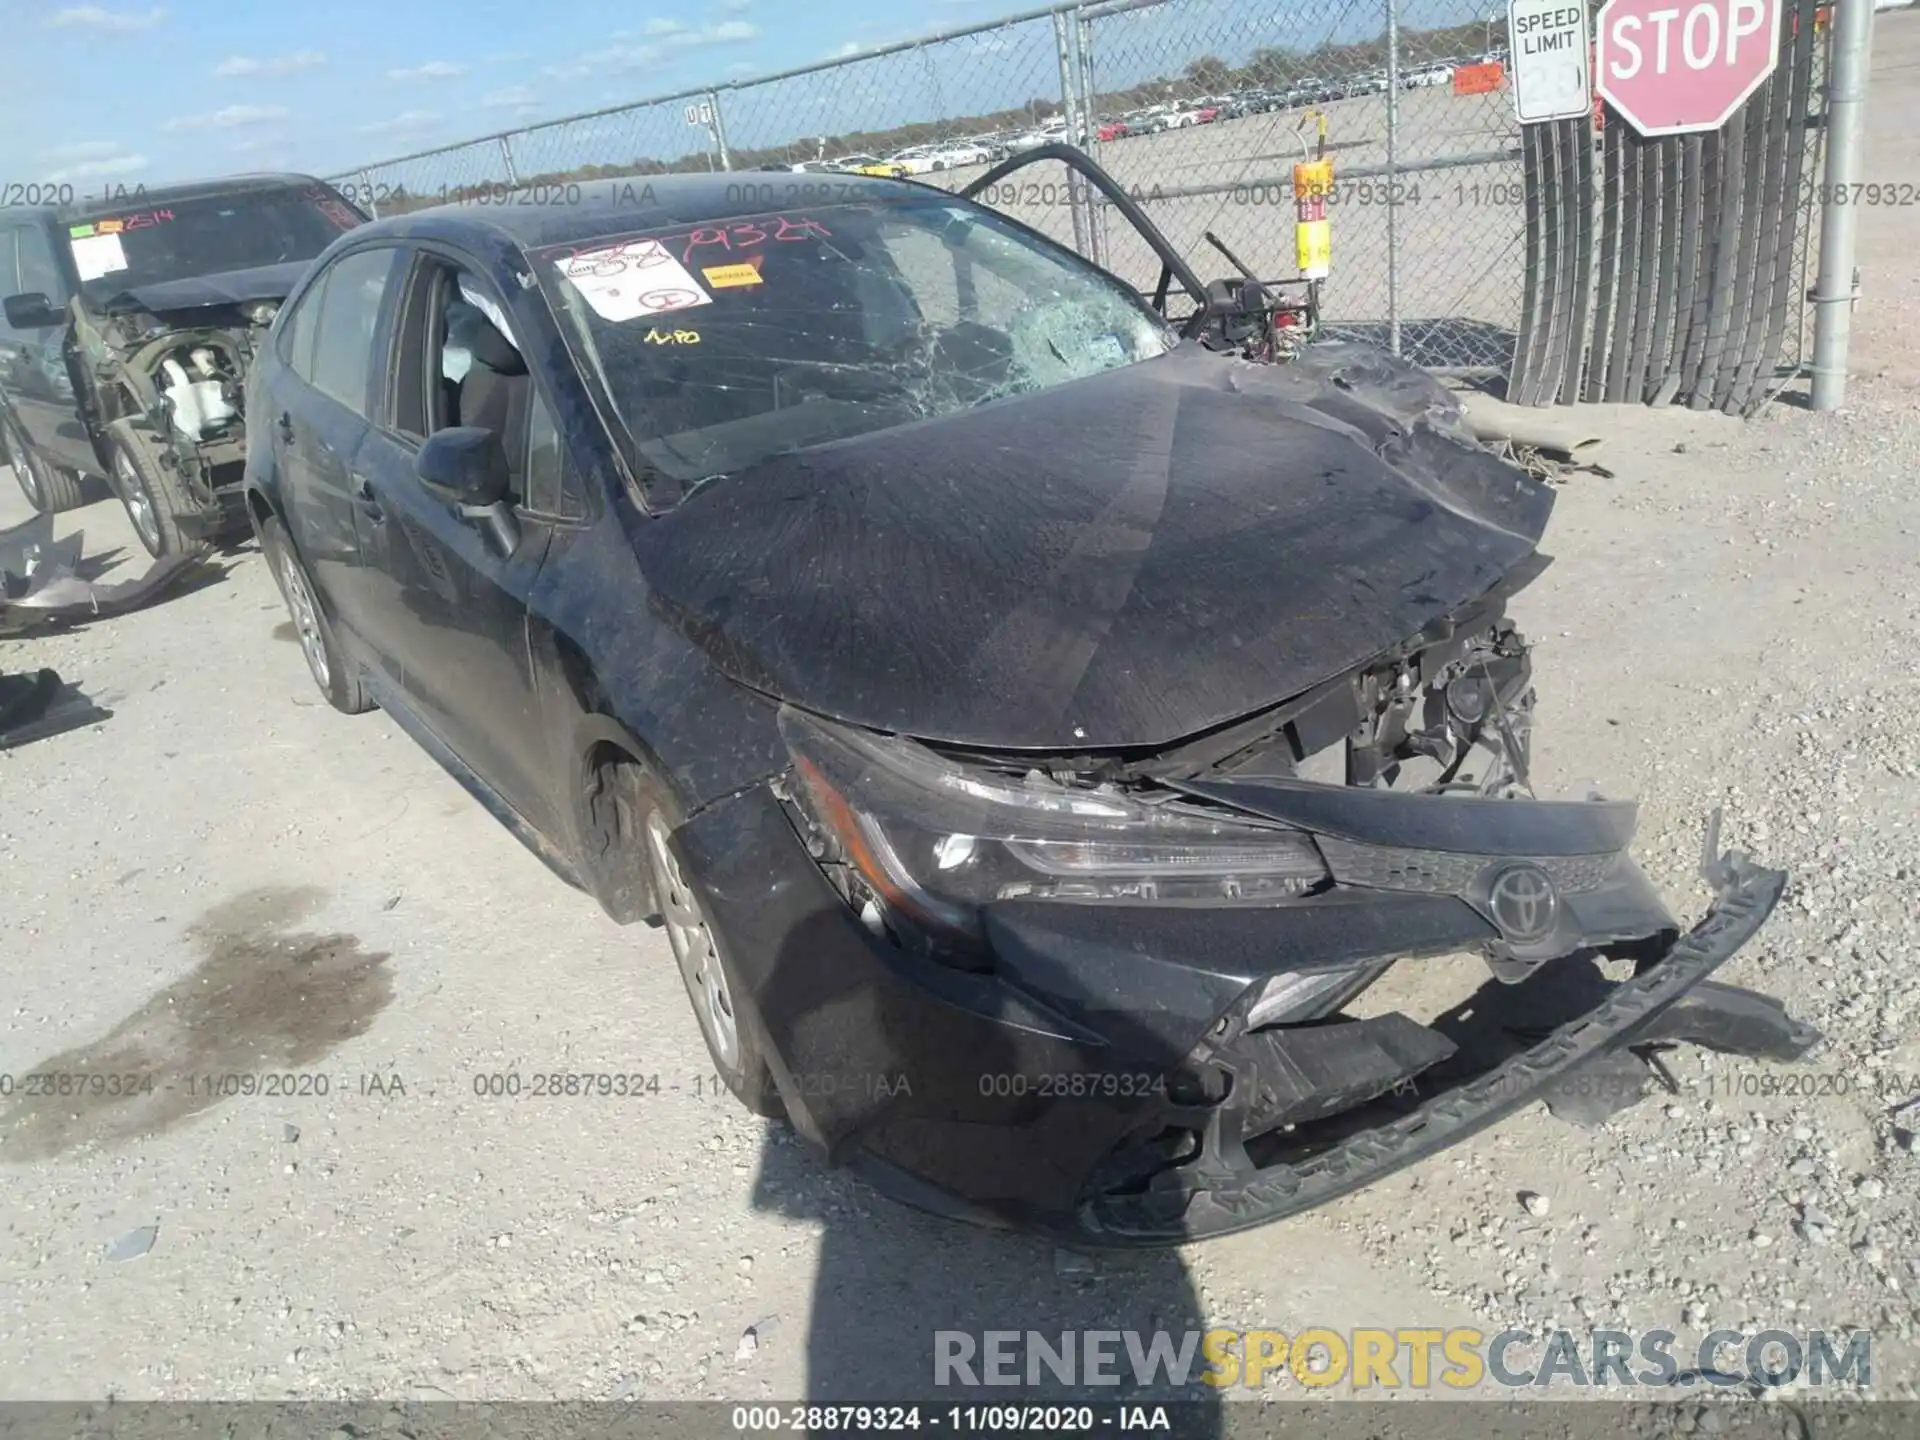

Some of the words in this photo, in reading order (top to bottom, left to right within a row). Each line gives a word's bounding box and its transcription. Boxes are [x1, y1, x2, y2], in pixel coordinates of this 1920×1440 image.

[1516, 7, 1580, 34] SPEED
[1524, 30, 1576, 55] LIMIT
[1609, 0, 1766, 80] STOP
